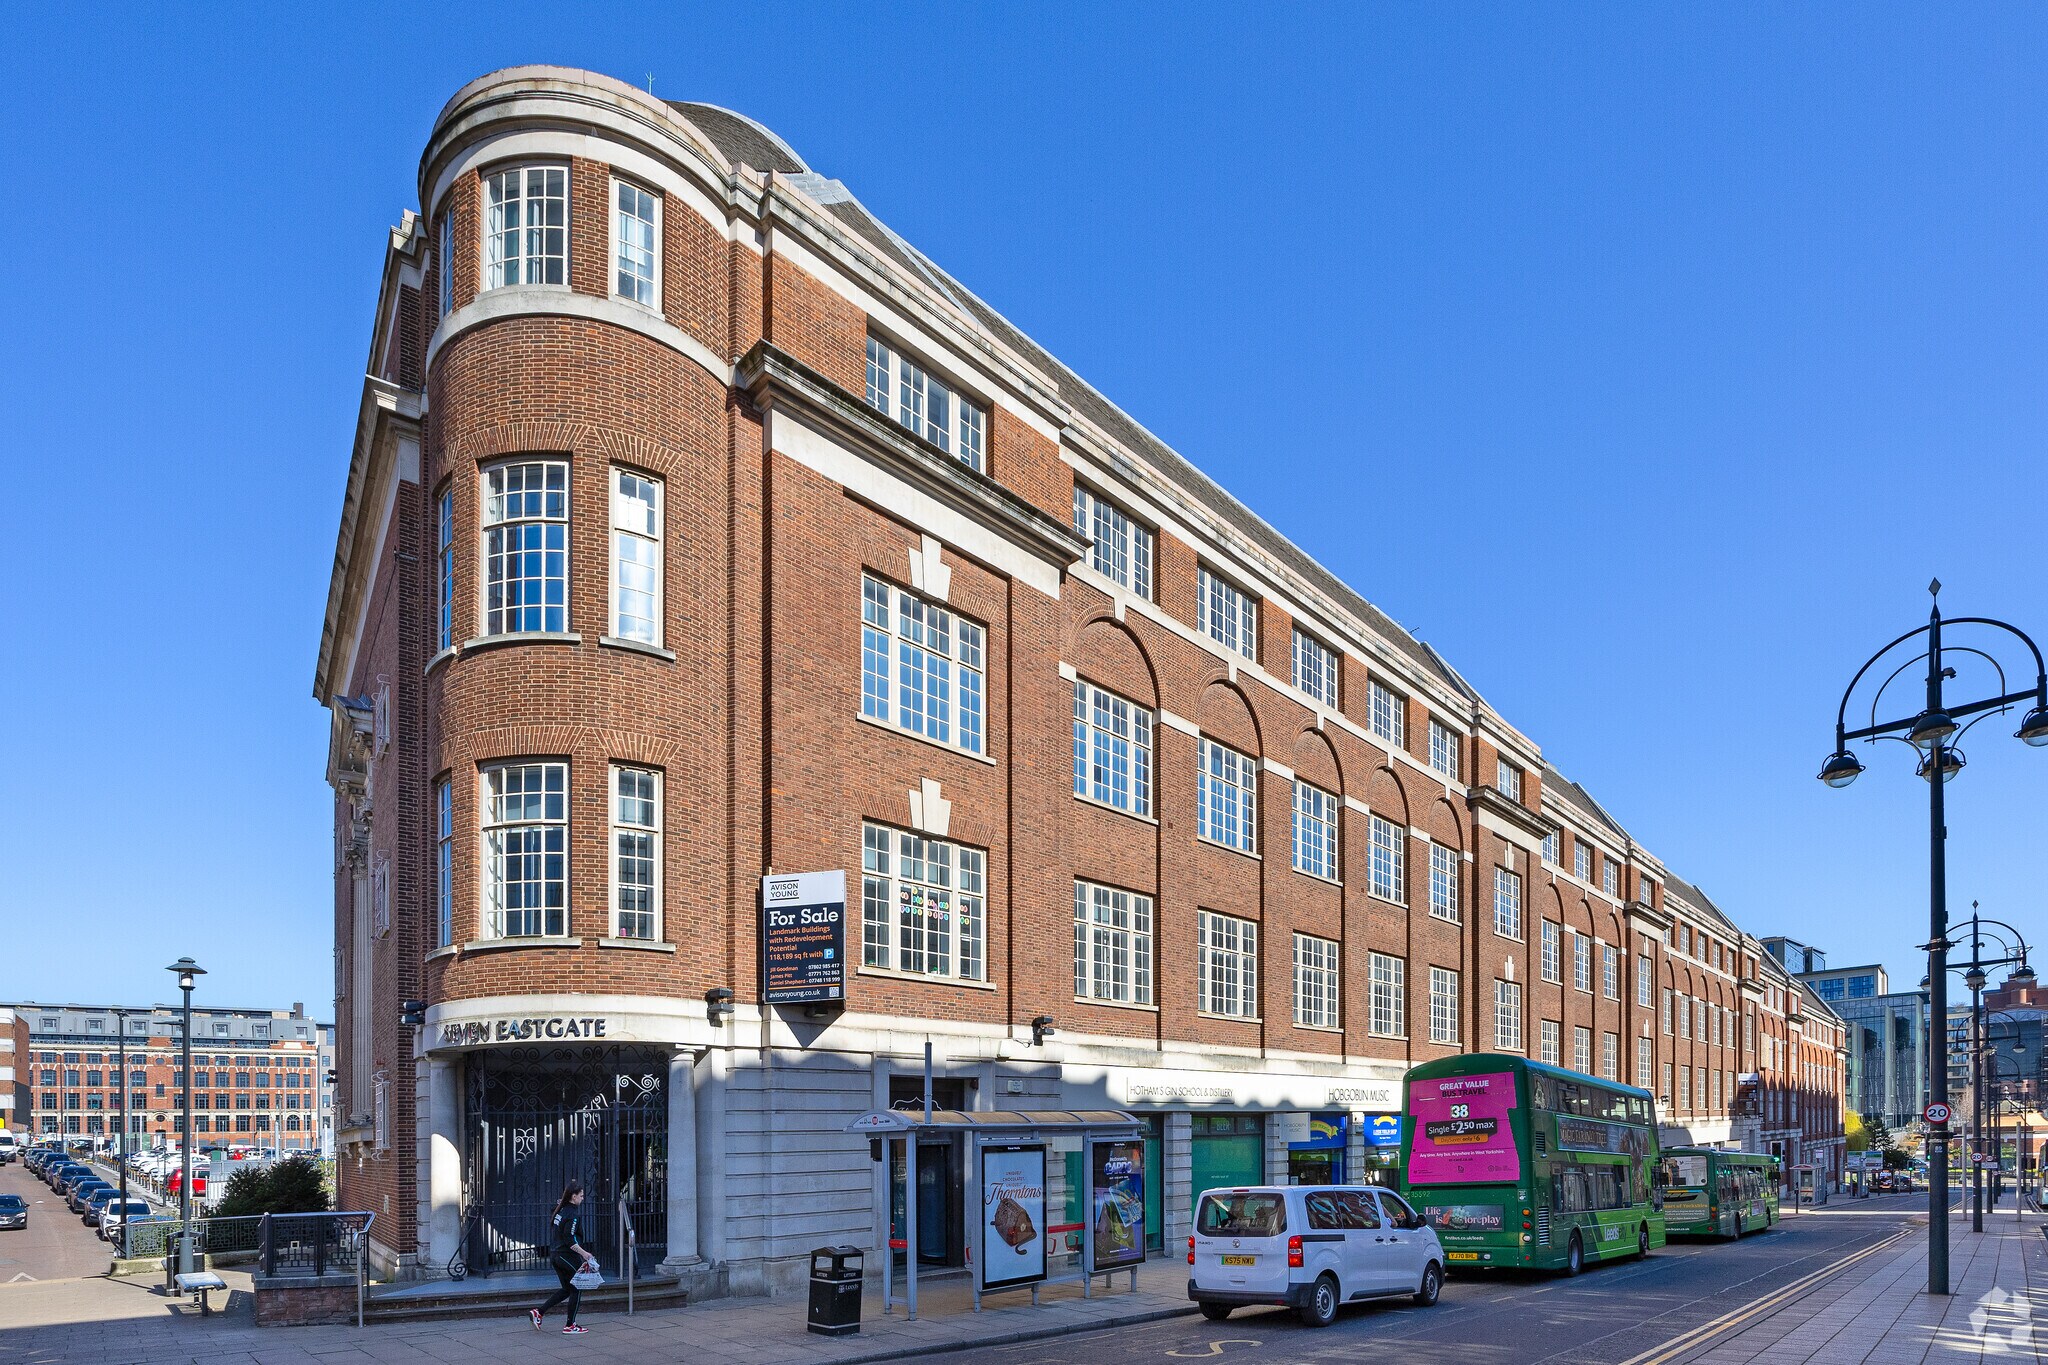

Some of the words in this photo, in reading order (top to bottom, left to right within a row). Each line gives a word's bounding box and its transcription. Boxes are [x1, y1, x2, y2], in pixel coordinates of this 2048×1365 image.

[771, 883, 798, 891] AVISON
[771, 890, 798, 898] YOUNG
[769, 911, 796, 926] For
[800, 907, 839, 924] Sale
[769, 927, 800, 936] Landmark
[802, 925, 831, 934] Buildings
[769, 936, 783, 944] with
[784, 934, 833, 943] Redevelopment
[769, 944, 797, 952] Potential
[769, 952, 793, 961] 118,189
[809, 950, 823, 958] with
[769, 989, 821, 998] avisonyoung.co.uk
[443, 1021, 491, 1043] SEVEN
[496, 1018, 607, 1041] EASTGATE
[1440, 1082, 1463, 1091] GREAT
[1465, 1080, 1489, 1088] VALUE
[1165, 1086, 1178, 1096] GIN
[1178, 1087, 1203, 1097] SCHOOL
[1204, 1088, 1209, 1097] &
[1209, 1088, 1233, 1097] DISTILLERY
[1328, 1088, 1369, 1101] HOBGOBLIN
[1370, 1090, 1390, 1102] MUSIC
[1459, 1088, 1487, 1096] TRAVEL
[1451, 1104, 1469, 1118] 38
[1928, 1108, 1947, 1118] 20
[1428, 1126, 1450, 1135] Single
[1476, 1121, 1494, 1129] max
[985, 1182, 1042, 1205] Thorntons
[1425, 1206, 1441, 1215] Life
[1435, 1215, 1443, 1223] is
[1604, 1225, 1619, 1241] Leeds
[1225, 1255, 1241, 1265] KS75
